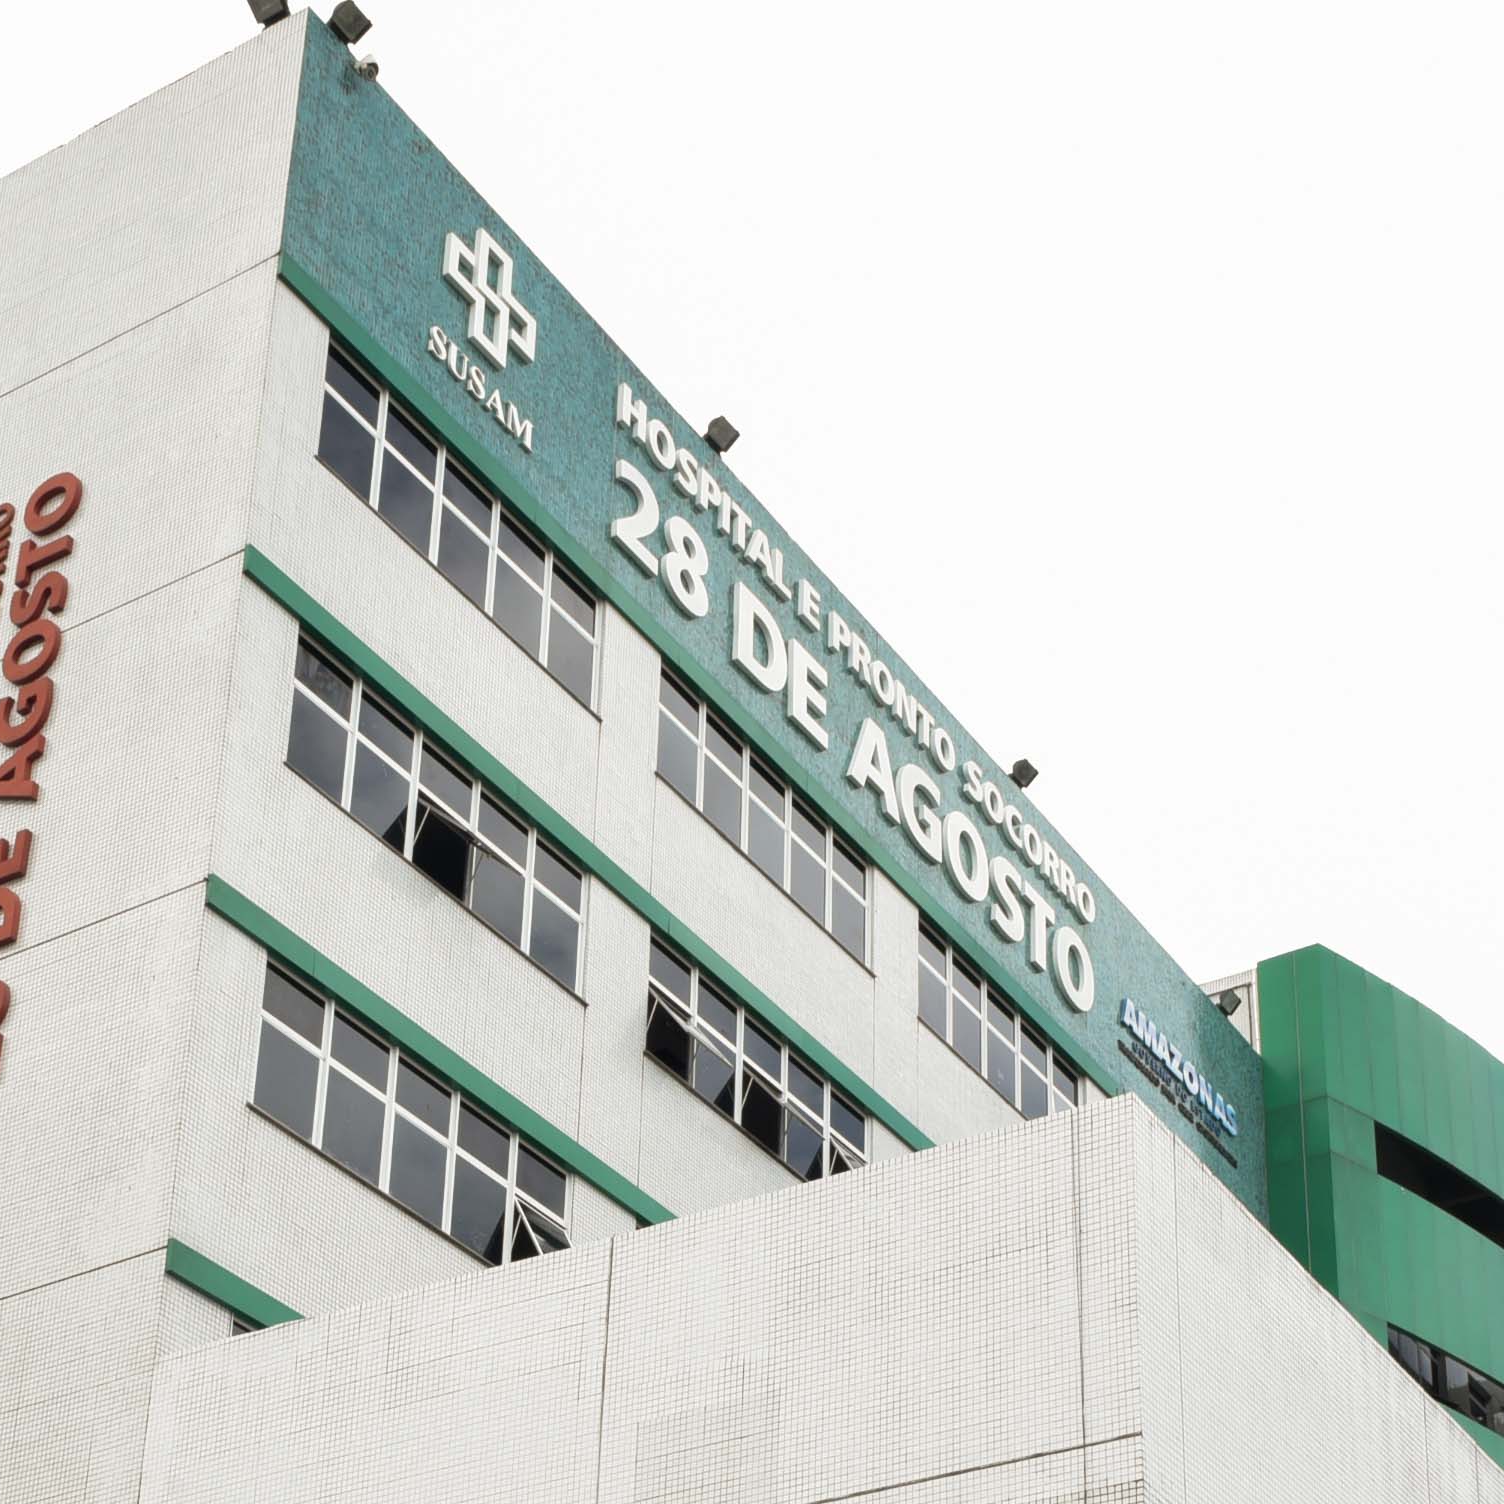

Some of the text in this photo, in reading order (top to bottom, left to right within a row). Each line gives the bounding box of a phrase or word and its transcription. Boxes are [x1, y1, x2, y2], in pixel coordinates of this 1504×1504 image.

[428, 326, 534, 452] SUSAM
[611, 459, 1095, 1012] 28 DE AGOSTO
[616, 382, 1096, 923] HOSPITAL E PRONTO SOCORRO
[1120, 998, 1238, 1136] AMAZONAS
